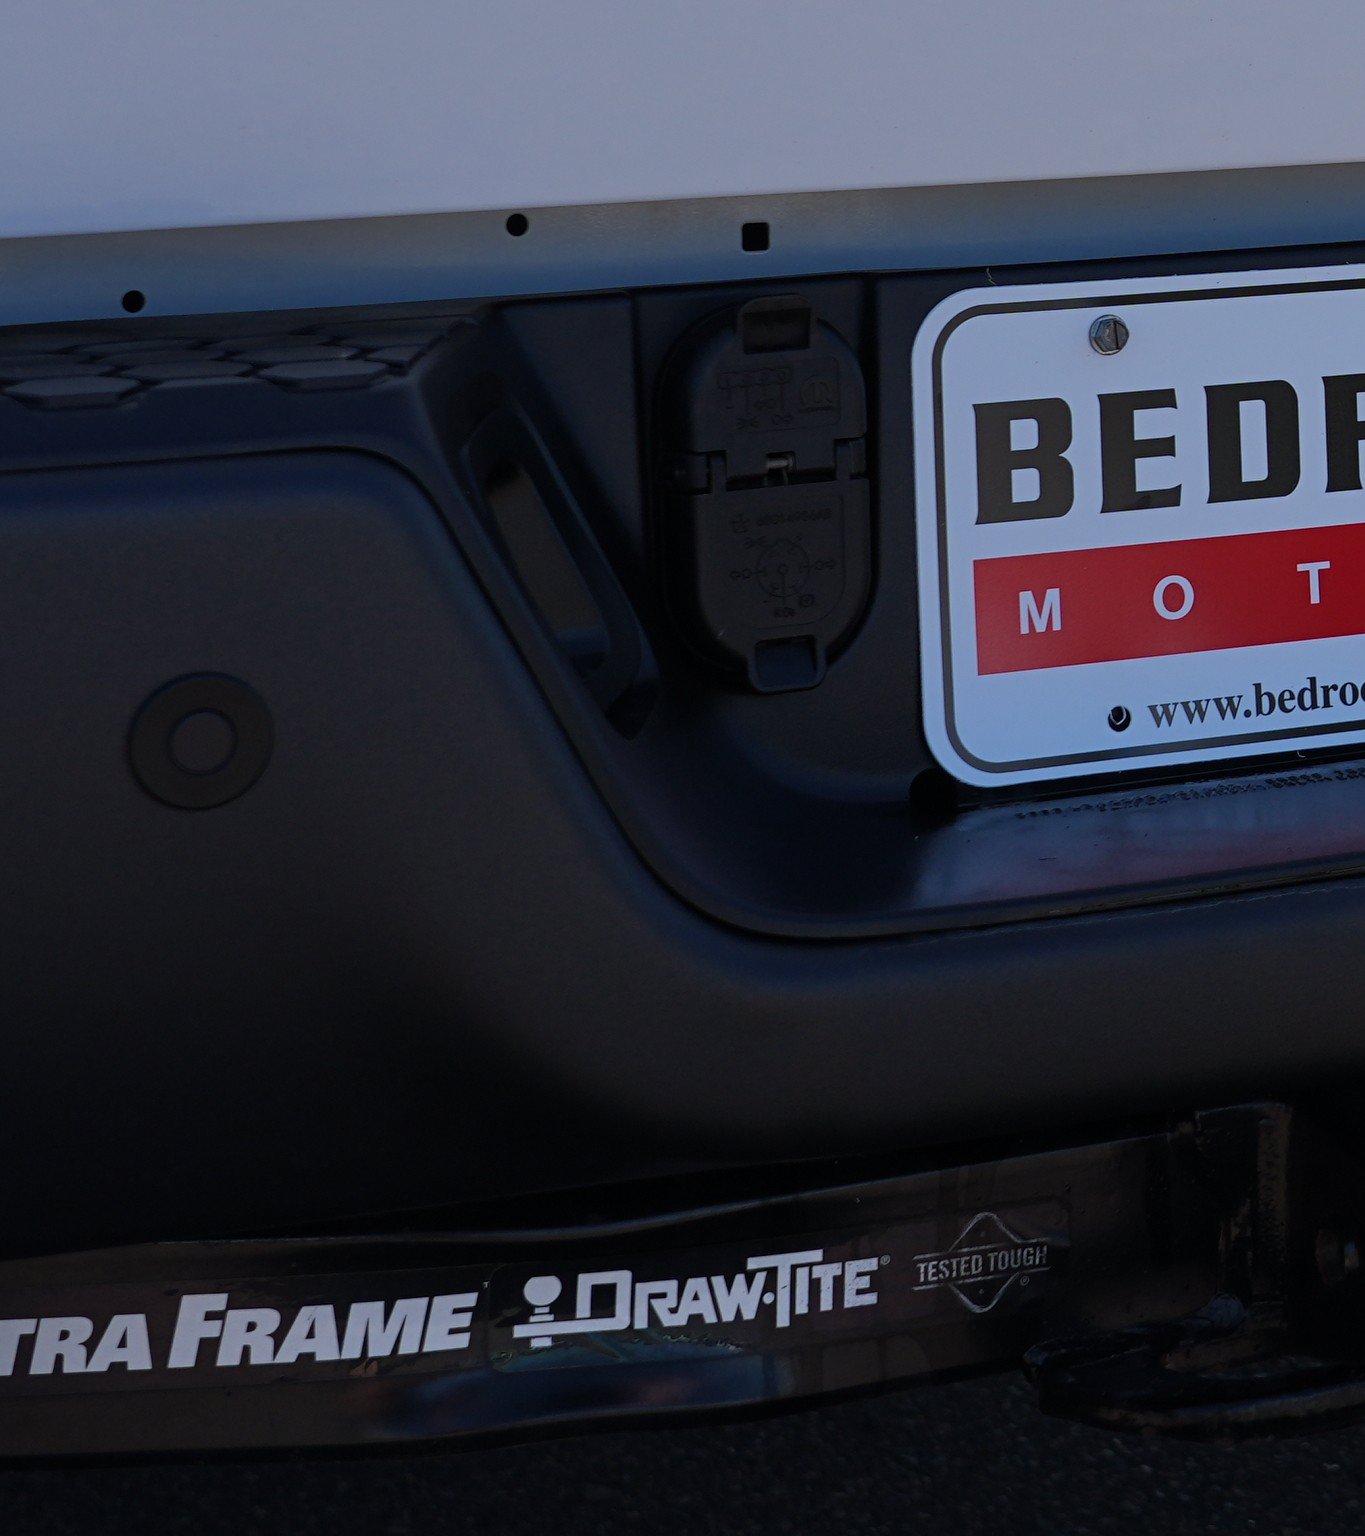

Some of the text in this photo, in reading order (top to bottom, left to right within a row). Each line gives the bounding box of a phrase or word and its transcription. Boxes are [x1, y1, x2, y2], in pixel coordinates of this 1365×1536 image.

[915, 1245, 1048, 1283] TESTED TOUGH
[0, 1291, 479, 1377] TRA FRAME
